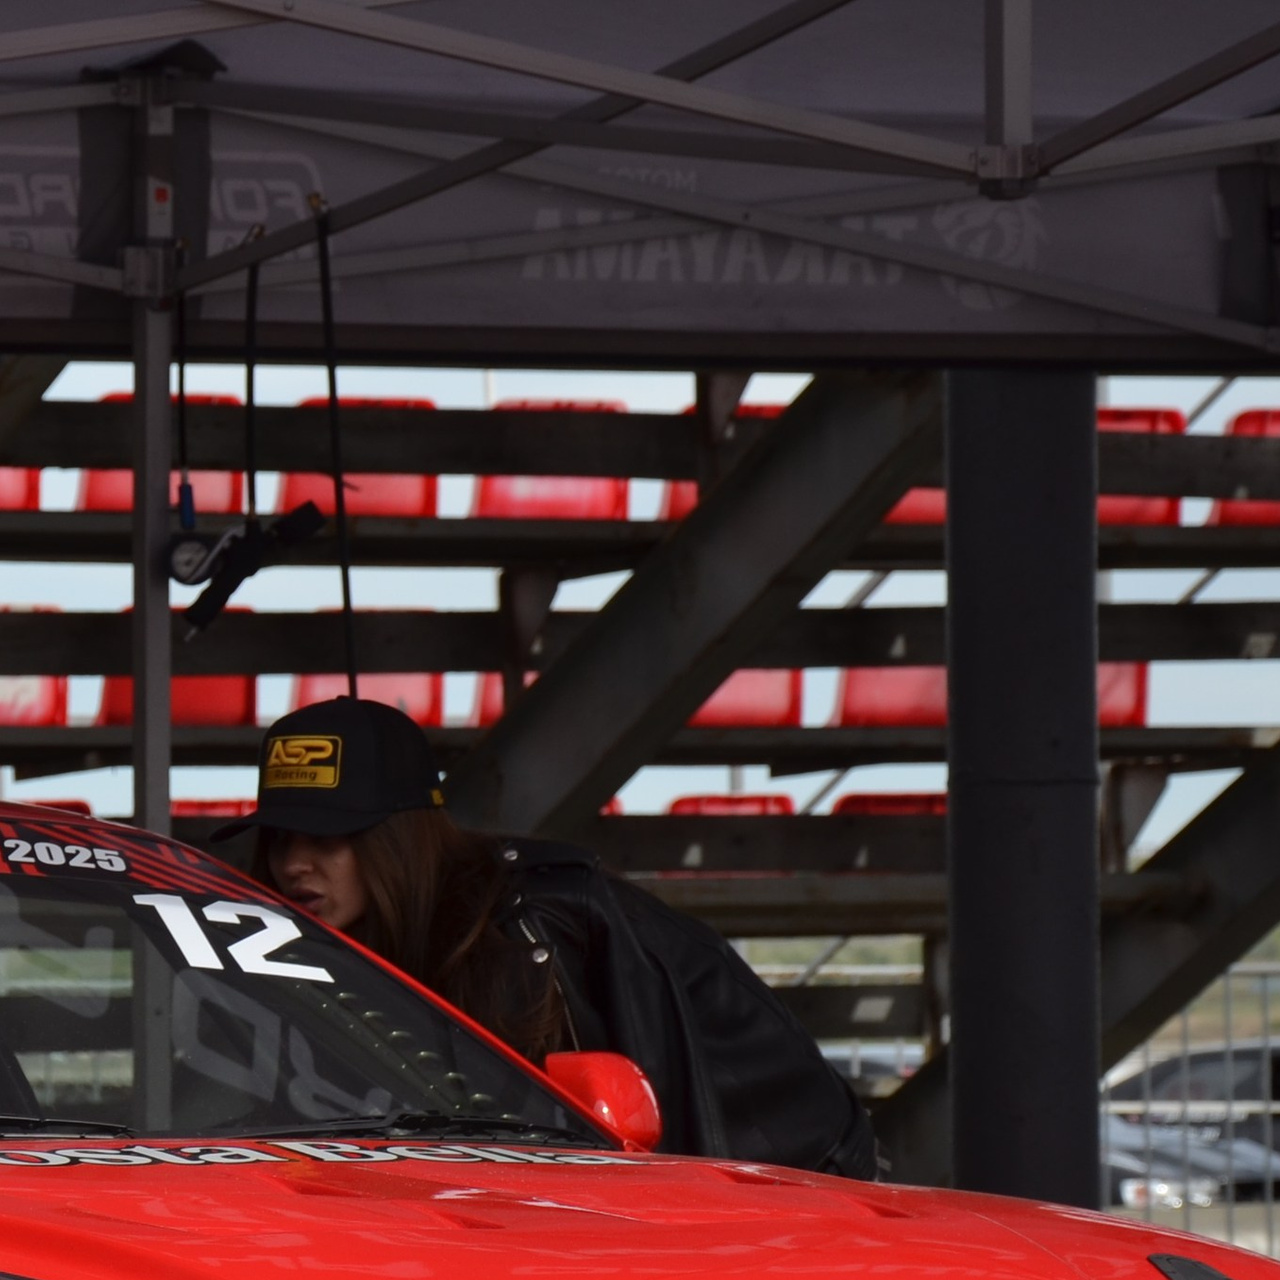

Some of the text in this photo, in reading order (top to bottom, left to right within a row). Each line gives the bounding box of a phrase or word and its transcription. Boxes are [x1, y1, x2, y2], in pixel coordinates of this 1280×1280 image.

[267, 739, 333, 766] ASP
[274, 768, 317, 781] Racing
[4, 839, 127, 872] 2025
[132, 893, 335, 983] 12
[266, 1141, 650, 1165] Bella
